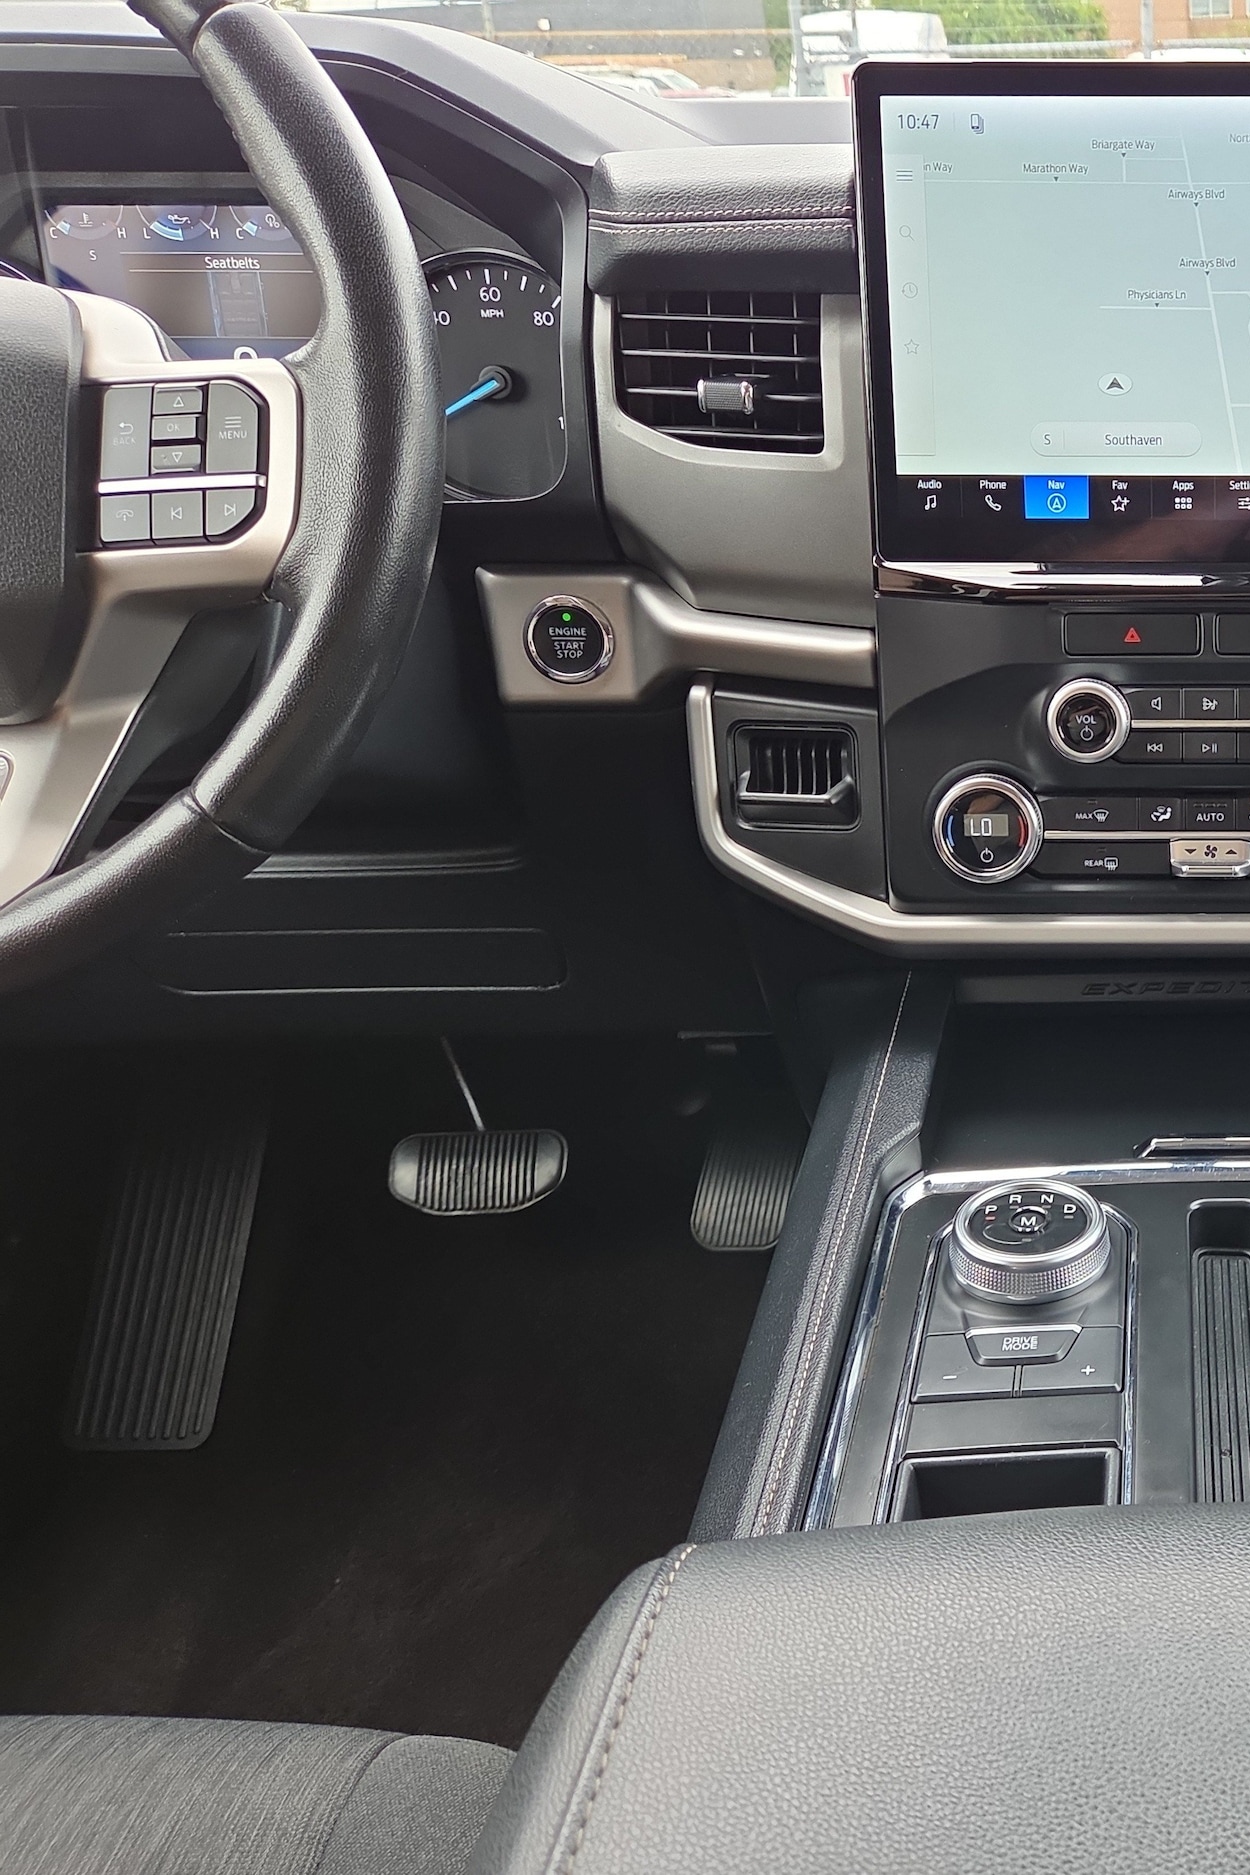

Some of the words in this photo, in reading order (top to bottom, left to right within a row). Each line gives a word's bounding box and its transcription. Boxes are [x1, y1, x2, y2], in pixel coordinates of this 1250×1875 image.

[897, 114, 940, 130] 10:47
[1091, 140, 1133, 151] Briargate
[1135, 140, 1155, 151] Way
[932, 162, 953, 173] Way
[1023, 163, 1067, 173] Marathon
[1068, 163, 1089, 174] Way
[1168, 189, 1203, 200] Airways
[1205, 189, 1225, 199] Blvd
[50, 228, 58, 239] C
[118, 228, 127, 239] H
[143, 228, 151, 239] L
[210, 228, 220, 239] H
[236, 228, 244, 239] C
[89, 250, 97, 261] S
[204, 256, 260, 270] Seatbelts
[1179, 258, 1215, 269] Airways
[1216, 258, 1236, 268] Blvd
[479, 287, 501, 302] 60
[1127, 289, 1173, 301] Physicians
[1175, 290, 1186, 299] Ln
[480, 309, 504, 318] MPH
[533, 311, 554, 326] 80
[167, 423, 180, 432] OK
[218, 430, 248, 440] MENU
[1104, 434, 1163, 446] Southaven
[113, 436, 136, 446] BACK
[917, 479, 942, 490] Audio
[979, 479, 1007, 490] Phone
[1048, 479, 1065, 490] Nav
[1111, 480, 1128, 490] Fav
[1172, 480, 1194, 492] Apps
[548, 627, 587, 636] ENGINE
[554, 641, 585, 650] START
[556, 650, 583, 659] STOP
[1076, 715, 1097, 725] VOL
[1075, 812, 1093, 820] MAX
[1196, 812, 1225, 822] AUTO
[1084, 860, 1103, 868] REAR
[1008, 1194, 1022, 1204] R
[1040, 1194, 1055, 1204] N
[984, 1205, 998, 1215] P
[1064, 1204, 1077, 1214] D
[1020, 1216, 1036, 1226] M
[1003, 1336, 1038, 1344] DRIVE
[1002, 1343, 1038, 1351] MODE
